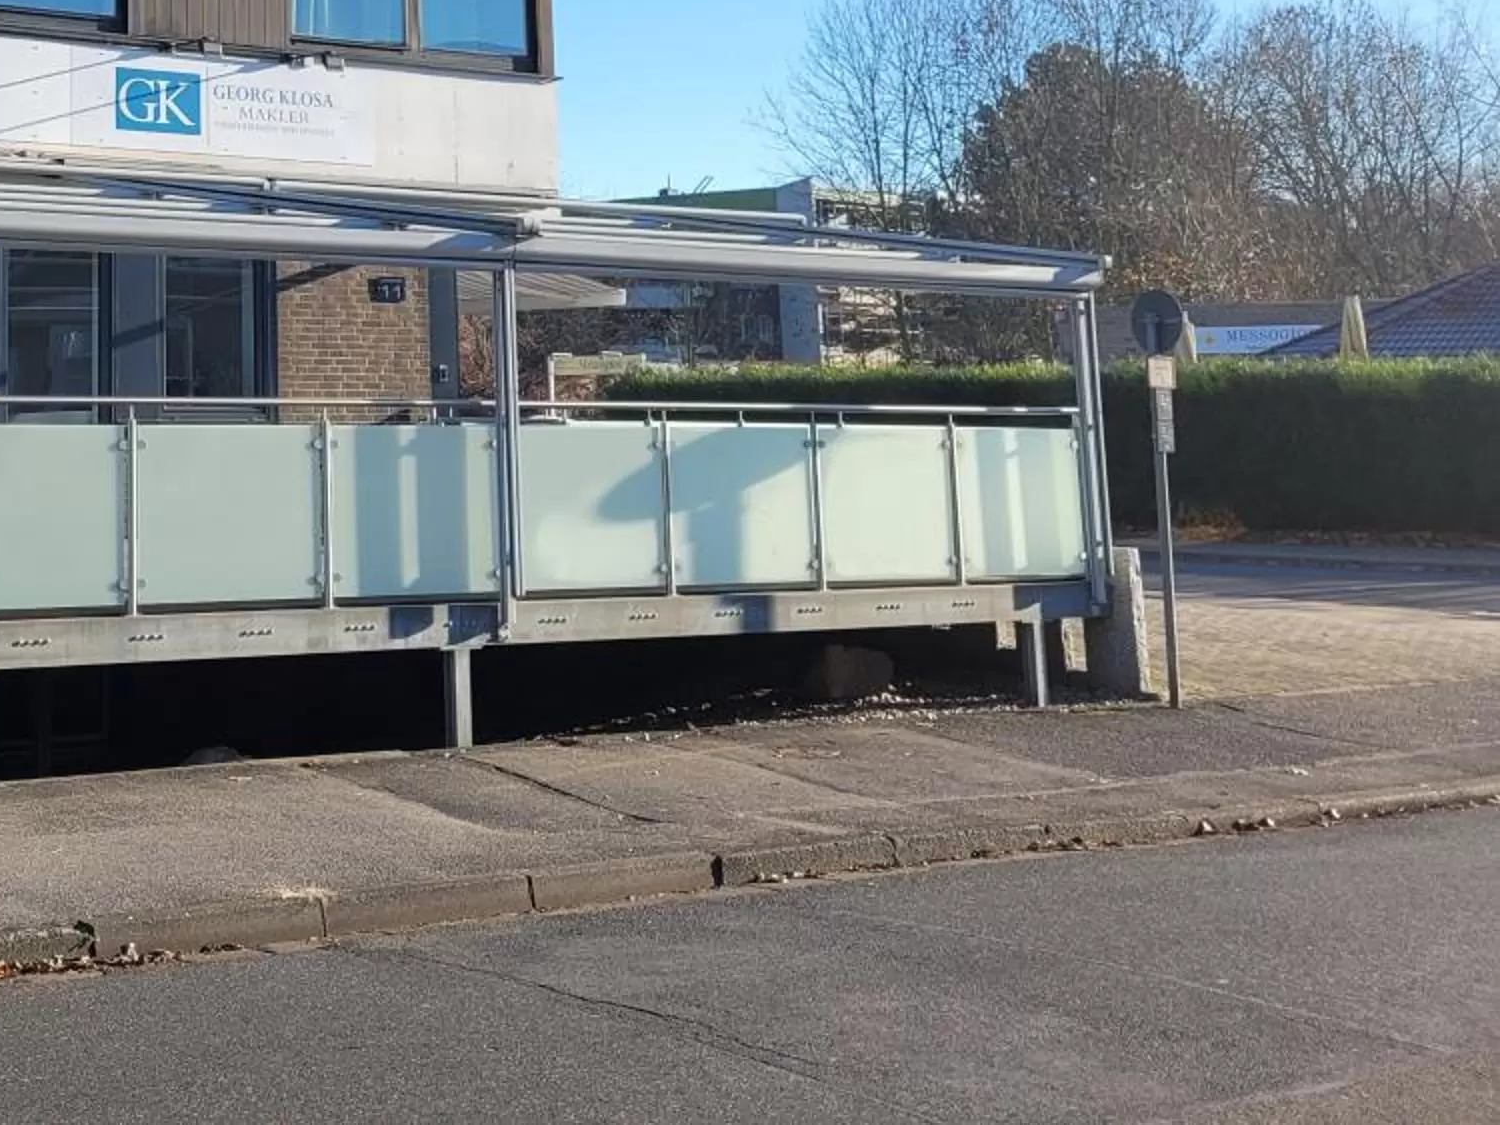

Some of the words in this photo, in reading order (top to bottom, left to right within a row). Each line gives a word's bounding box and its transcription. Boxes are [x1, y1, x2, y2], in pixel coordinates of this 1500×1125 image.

[118, 77, 197, 126] GK
[213, 84, 274, 104] GEORG
[279, 89, 334, 108] KLOSA
[239, 106, 309, 124] MAKLER
